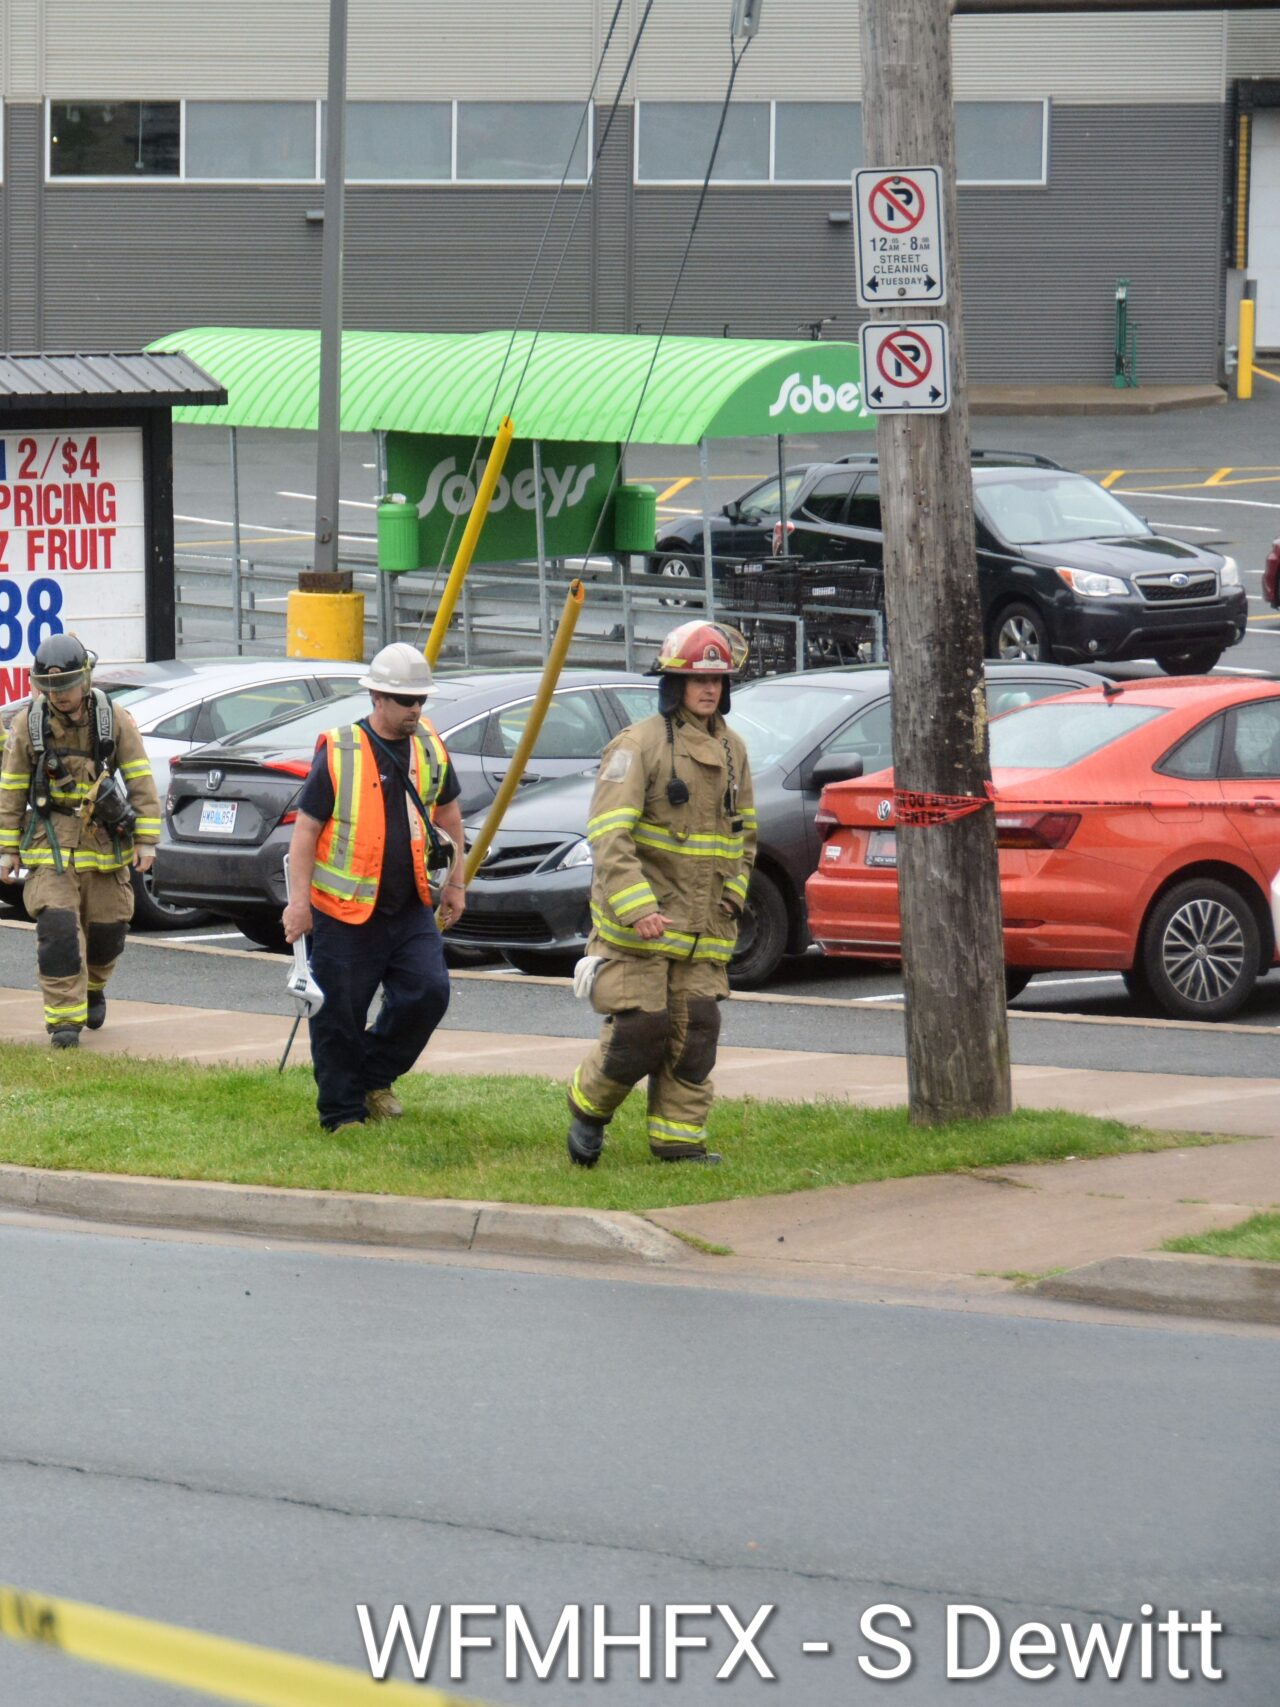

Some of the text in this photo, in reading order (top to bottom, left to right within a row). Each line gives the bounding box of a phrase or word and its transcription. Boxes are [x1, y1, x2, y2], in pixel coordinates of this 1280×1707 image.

[873, 264, 929, 274] CLEANING
[879, 254, 922, 264] STREET
[880, 277, 923, 286] TUESDAY
[769, 372, 869, 417] Sobe
[17, 436, 100, 480] 2/$4
[416, 455, 596, 519] Sobeys
[26, 528, 117, 572] FRUIT
